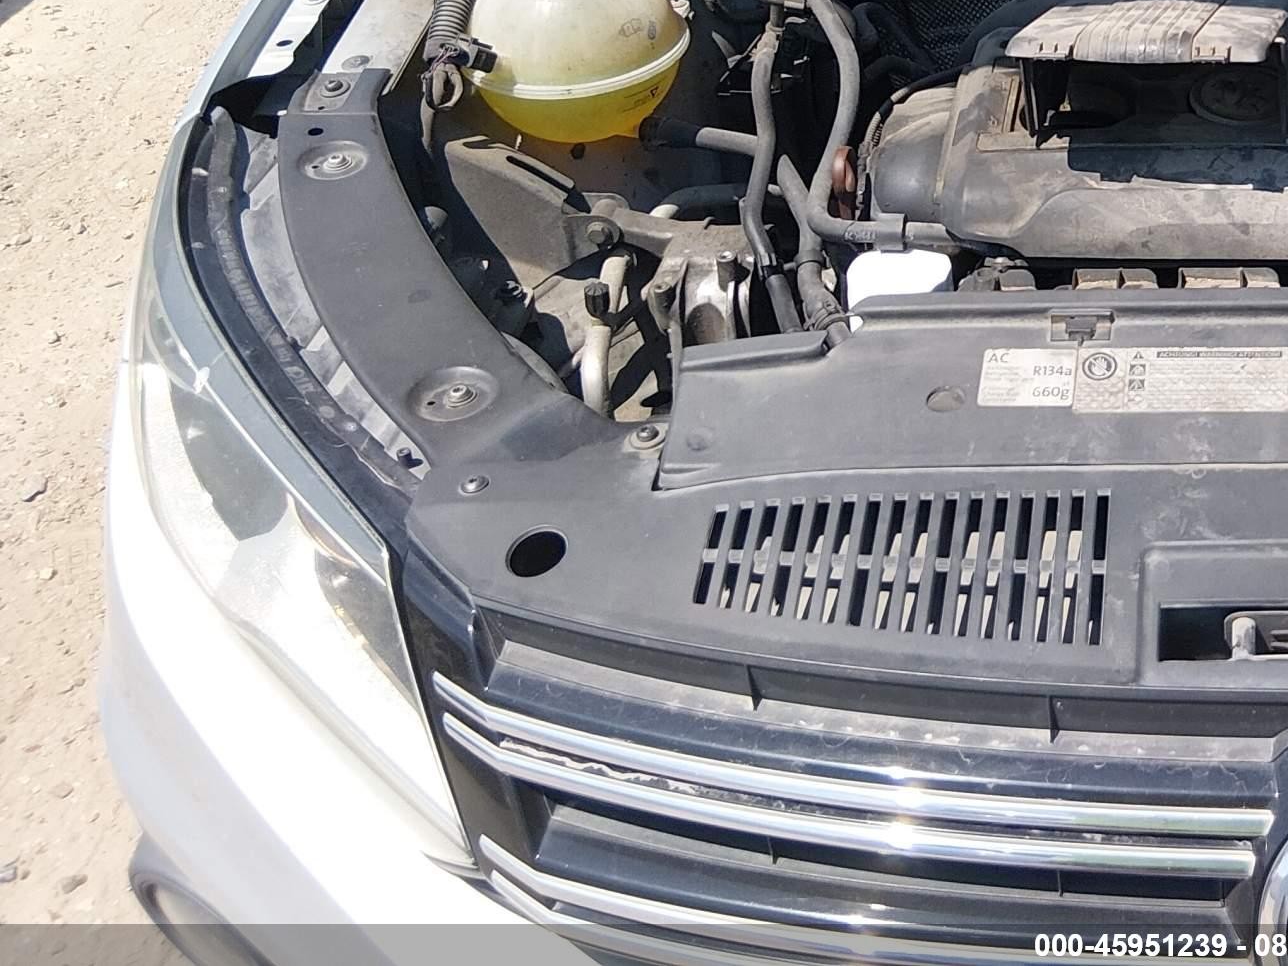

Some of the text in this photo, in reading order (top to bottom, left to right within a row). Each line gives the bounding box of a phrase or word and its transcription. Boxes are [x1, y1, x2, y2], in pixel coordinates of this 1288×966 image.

[987, 352, 1010, 364] AC
[1032, 365, 1073, 377] R134a
[1031, 386, 1070, 401] 660g
